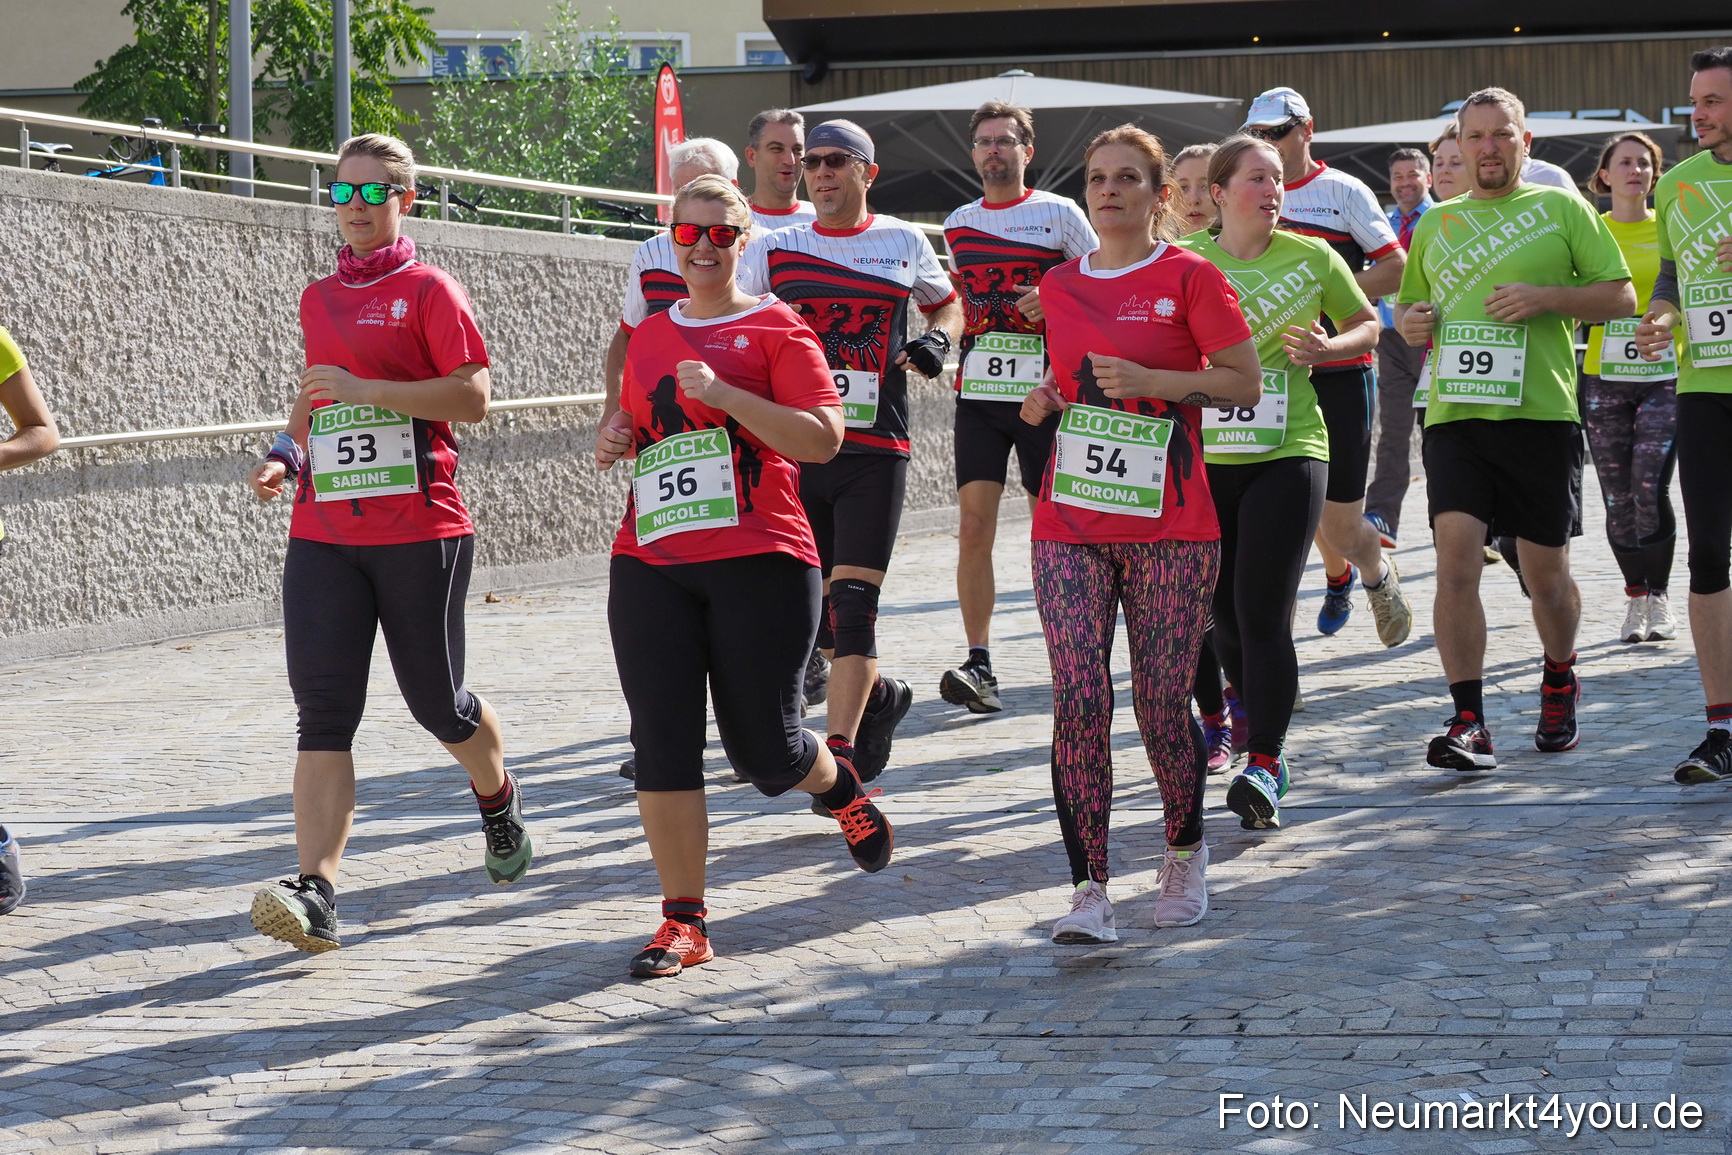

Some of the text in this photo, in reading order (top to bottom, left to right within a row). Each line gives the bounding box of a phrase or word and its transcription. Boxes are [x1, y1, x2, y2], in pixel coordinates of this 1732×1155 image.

[1289, 206, 1332, 214] NEUMARKT
[1004, 225, 1044, 233] NEUMARKT
[853, 257, 901, 267] NEUMARKT
[1463, 273, 1482, 291] UND
[1481, 222, 1560, 274] GEBÄUDETECHNIK
[356, 319, 385, 327] nürnberg
[1116, 315, 1148, 323] nürnberg
[1253, 282, 1323, 343] GEBÄUDETECHNIK
[976, 334, 1037, 353] BOCK
[1446, 325, 1518, 346] BOCK
[987, 356, 1016, 378] 81
[1458, 350, 1494, 375] 99
[1613, 364, 1664, 375] RAMONA
[1445, 382, 1507, 395] STEPHAN
[318, 404, 403, 433] BOCK
[1066, 408, 1161, 444] BOCK
[401, 431, 411, 439] E6
[1216, 431, 1257, 442] ANNA
[337, 433, 378, 466] 53
[640, 433, 721, 474] BOCK
[1085, 443, 1128, 479] 54
[331, 471, 392, 489] SABINE
[658, 467, 698, 502] 56
[1071, 480, 1140, 504] KORONA
[652, 504, 711, 528] NICOLE
